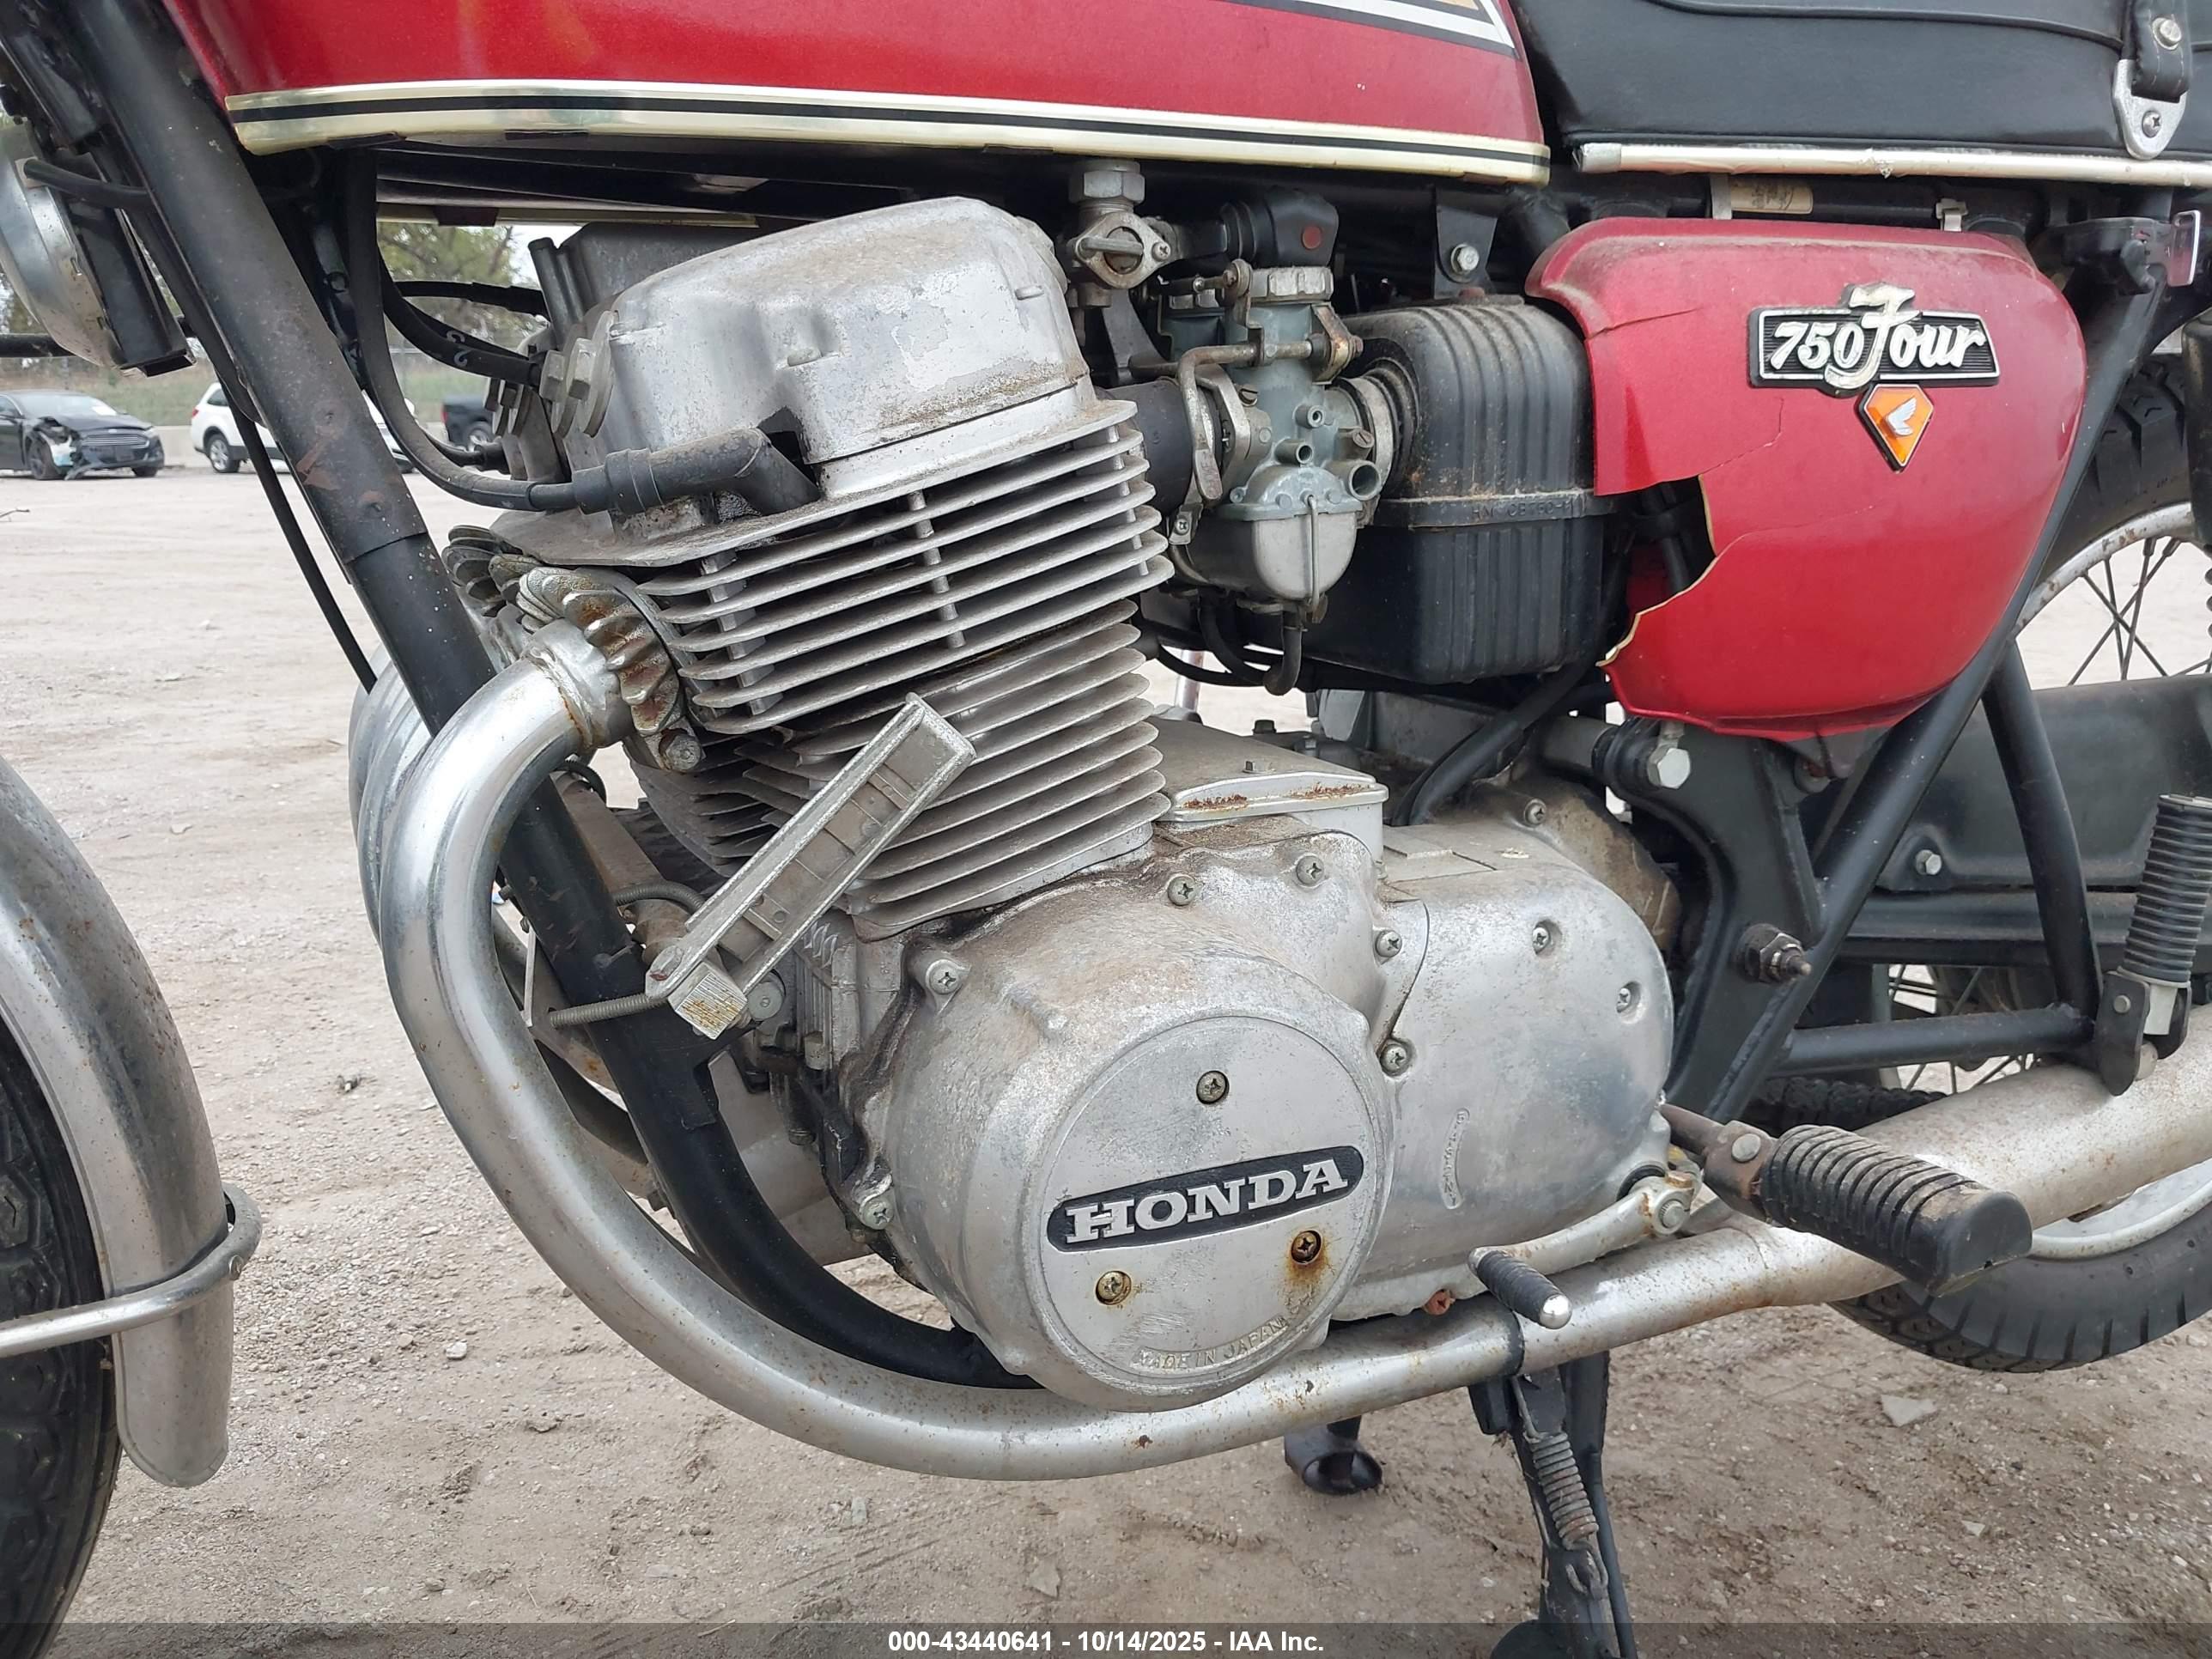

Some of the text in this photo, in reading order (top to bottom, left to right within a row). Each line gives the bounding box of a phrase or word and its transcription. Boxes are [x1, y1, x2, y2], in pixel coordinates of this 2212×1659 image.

[1771, 282, 1987, 390] 750 Four
[1066, 1158, 1348, 1243] HONDA
[1196, 1351, 1216, 1367] IN
[1224, 1315, 1288, 1359] JAPAN
